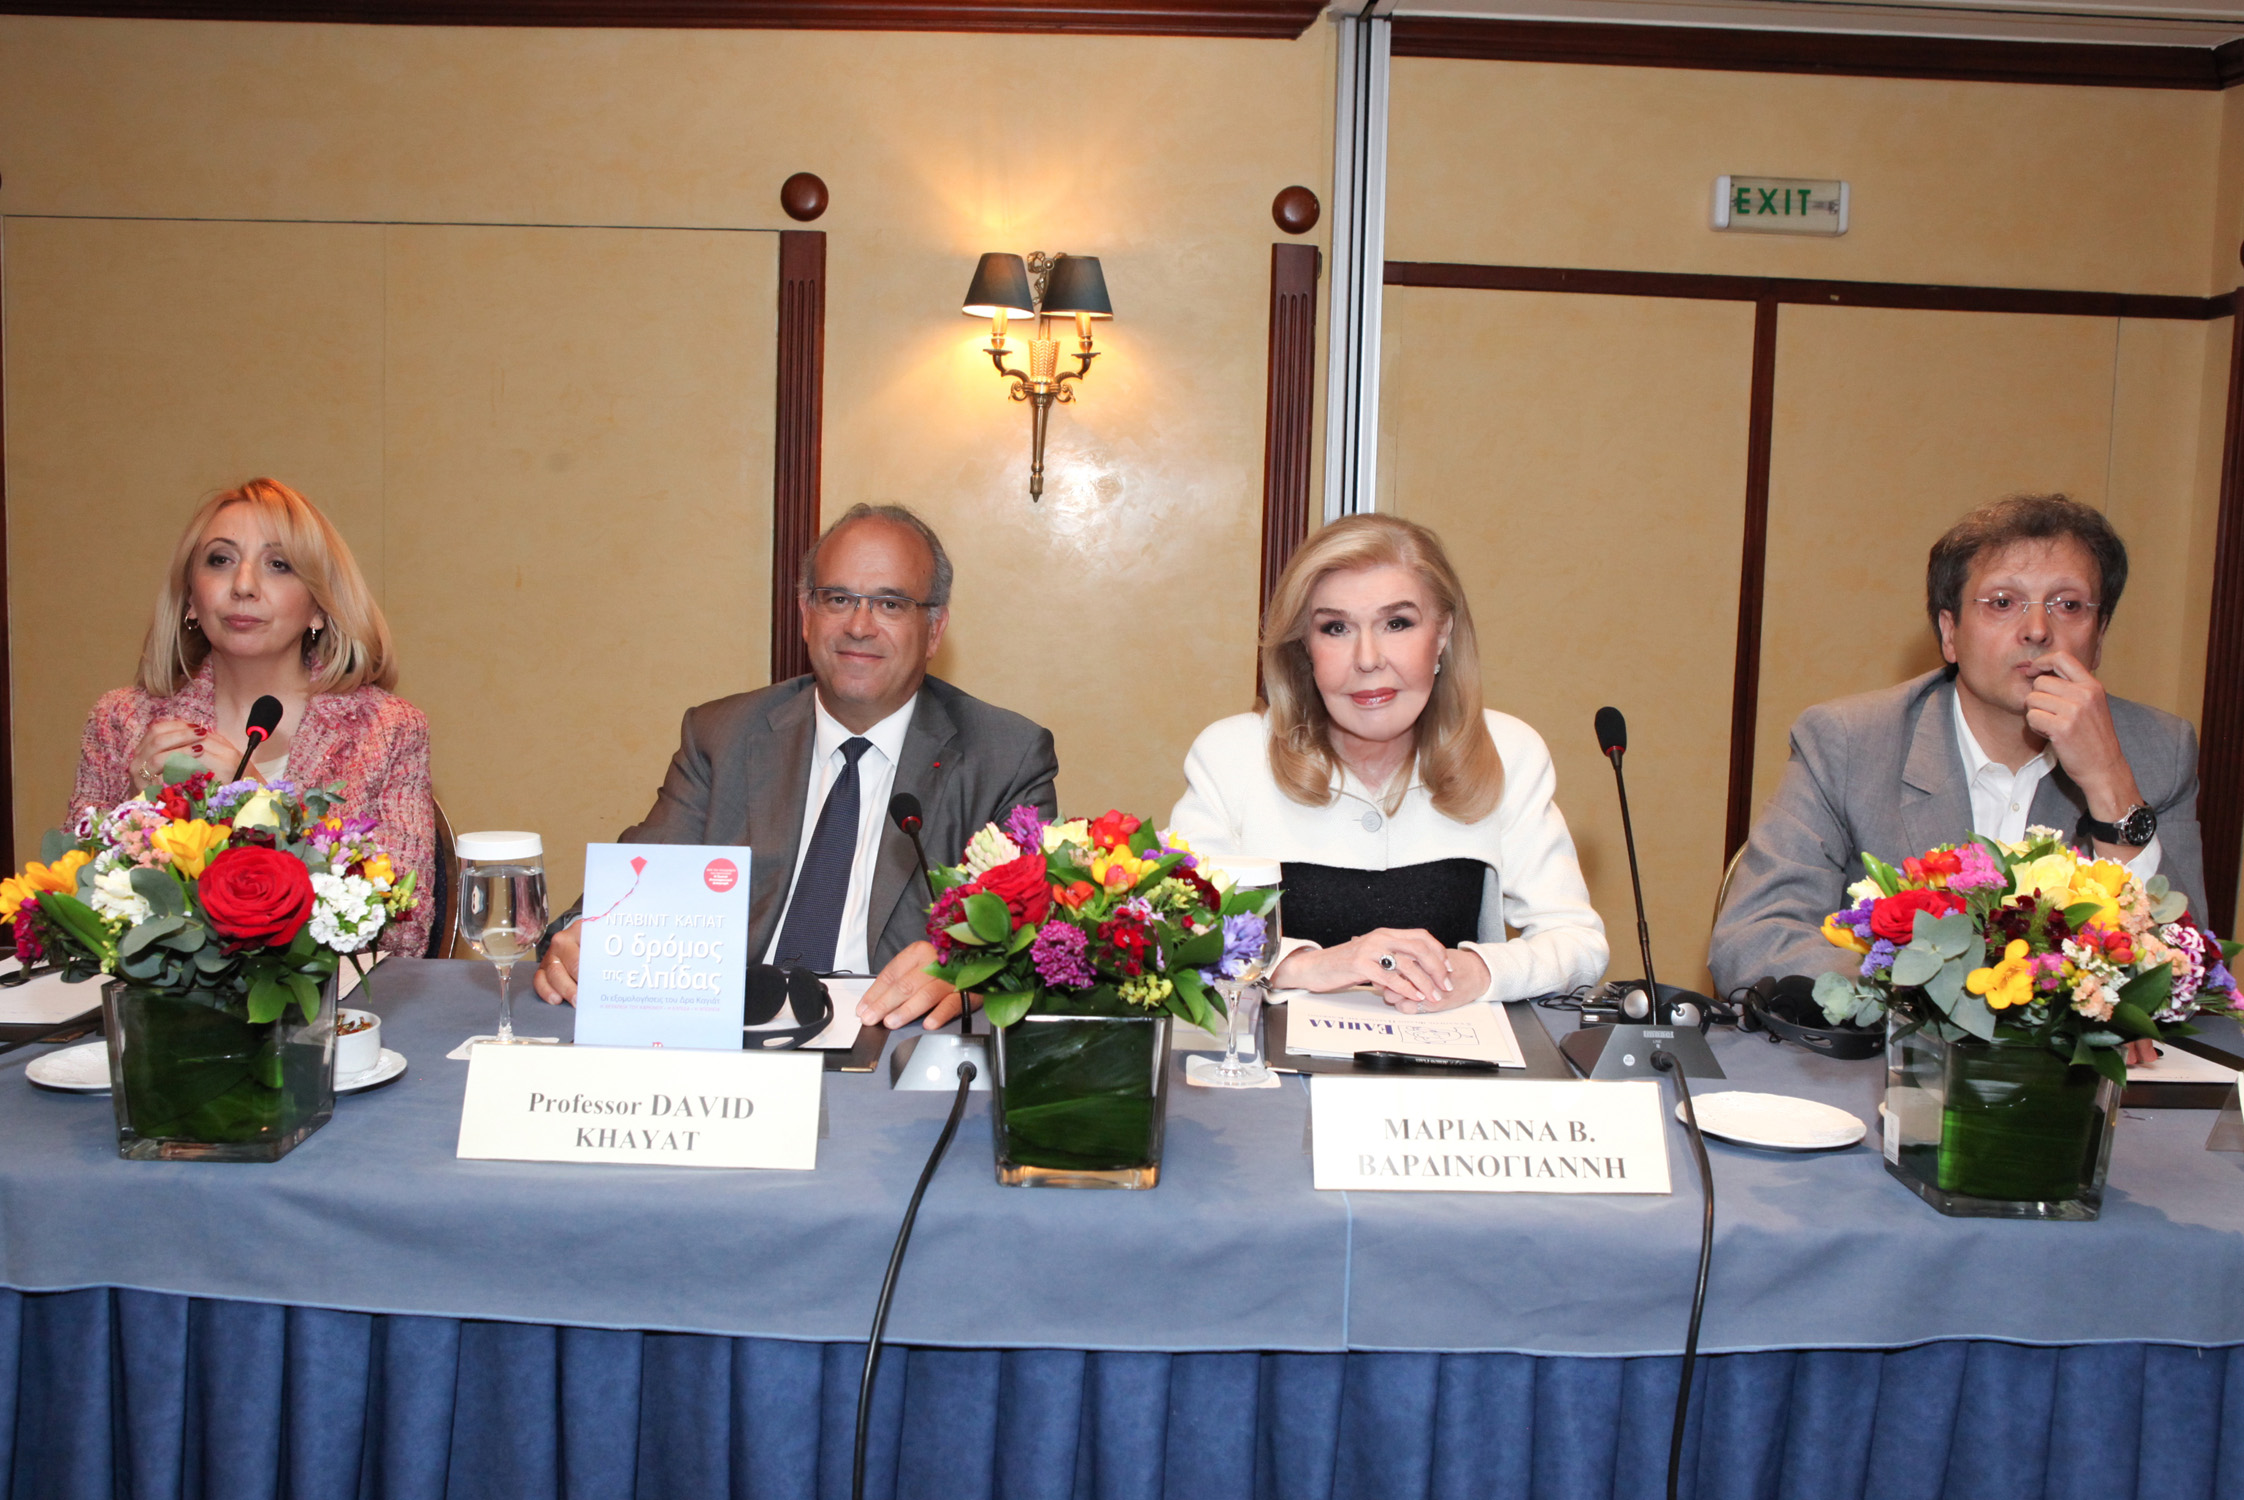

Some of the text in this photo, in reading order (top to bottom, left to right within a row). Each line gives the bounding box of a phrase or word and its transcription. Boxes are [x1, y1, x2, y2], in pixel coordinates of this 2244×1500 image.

[1736, 187, 1811, 216] EXIT
[605, 912, 725, 929] ΝΤΑΒΙΝΤ ΚΑΓΙΑΤ
[604, 932, 724, 964] Ο δρόμος
[602, 964, 721, 995] της ελπίδας
[528, 1091, 754, 1119] Professor DAVID
[575, 1126, 700, 1151] KHAYAT
[1384, 1117, 1596, 1143] ΜΑΡΙΑΝΝΑ Β.
[1357, 1154, 1628, 1179] ΒΑΡΔΙΝΟΓΙΑΝΝΗ
